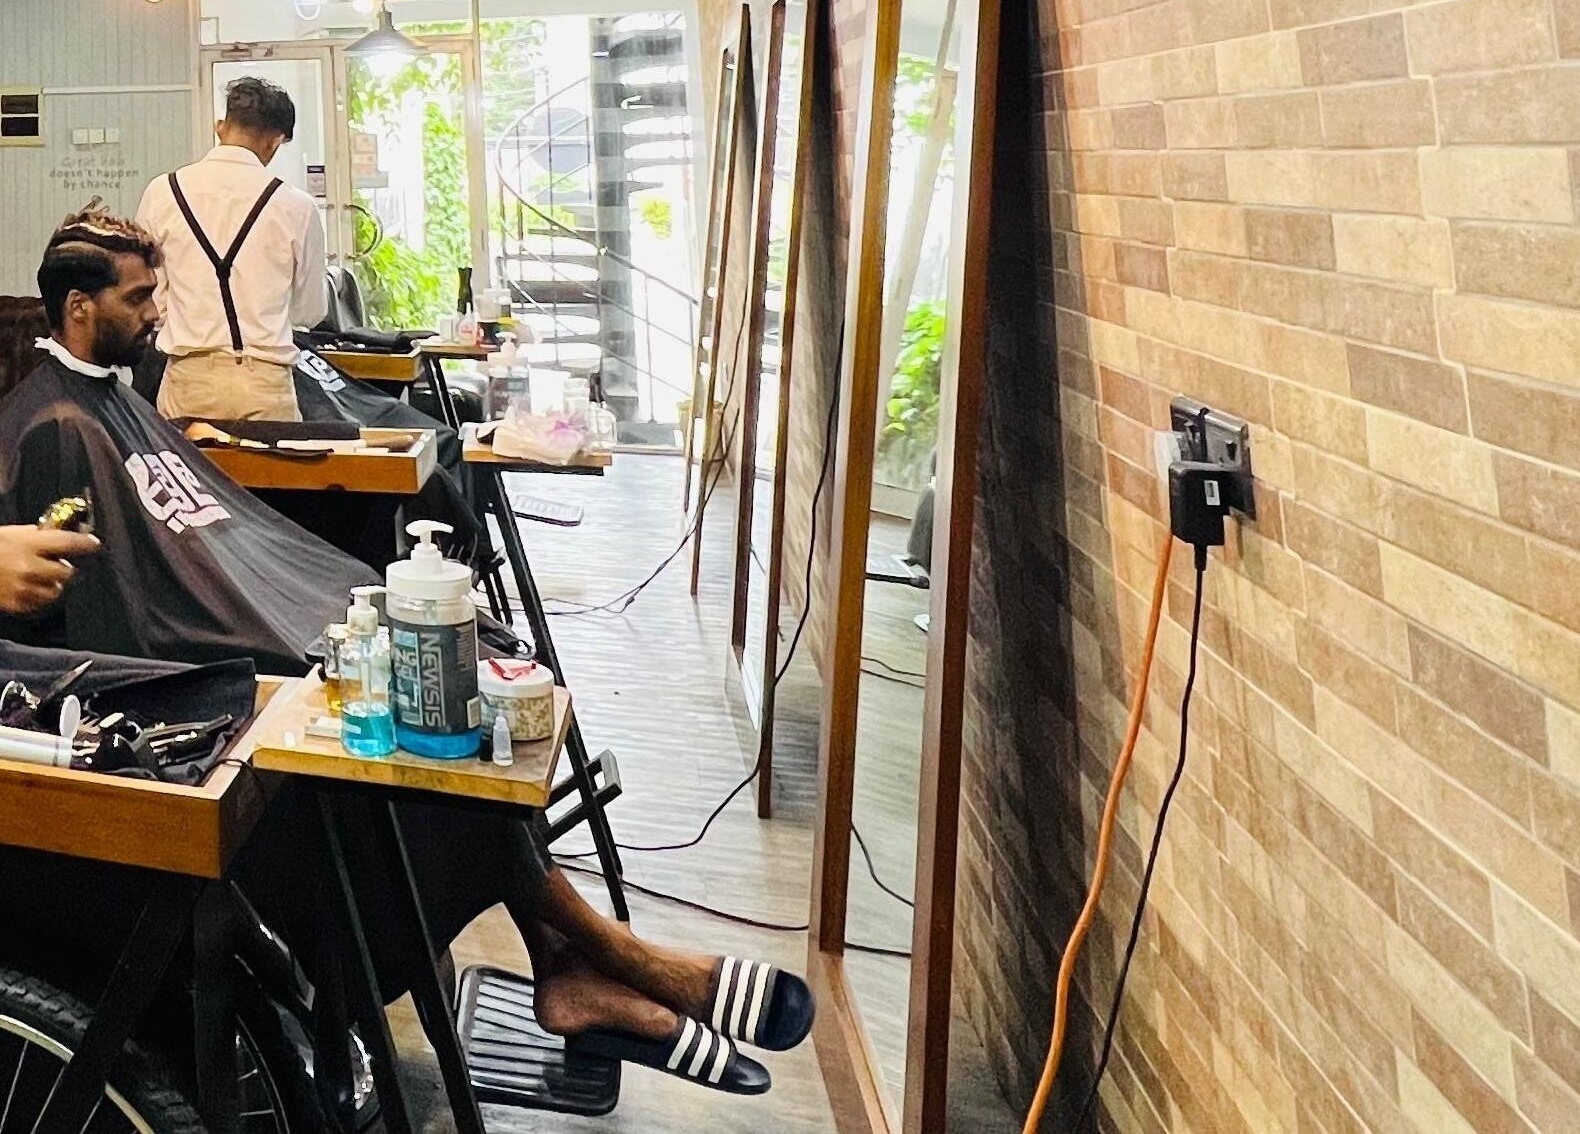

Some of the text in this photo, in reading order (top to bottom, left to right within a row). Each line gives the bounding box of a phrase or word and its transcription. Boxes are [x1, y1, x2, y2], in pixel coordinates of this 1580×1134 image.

[49, 169, 139, 179] doesn't happen
[419, 632, 442, 727] NEWSIS
